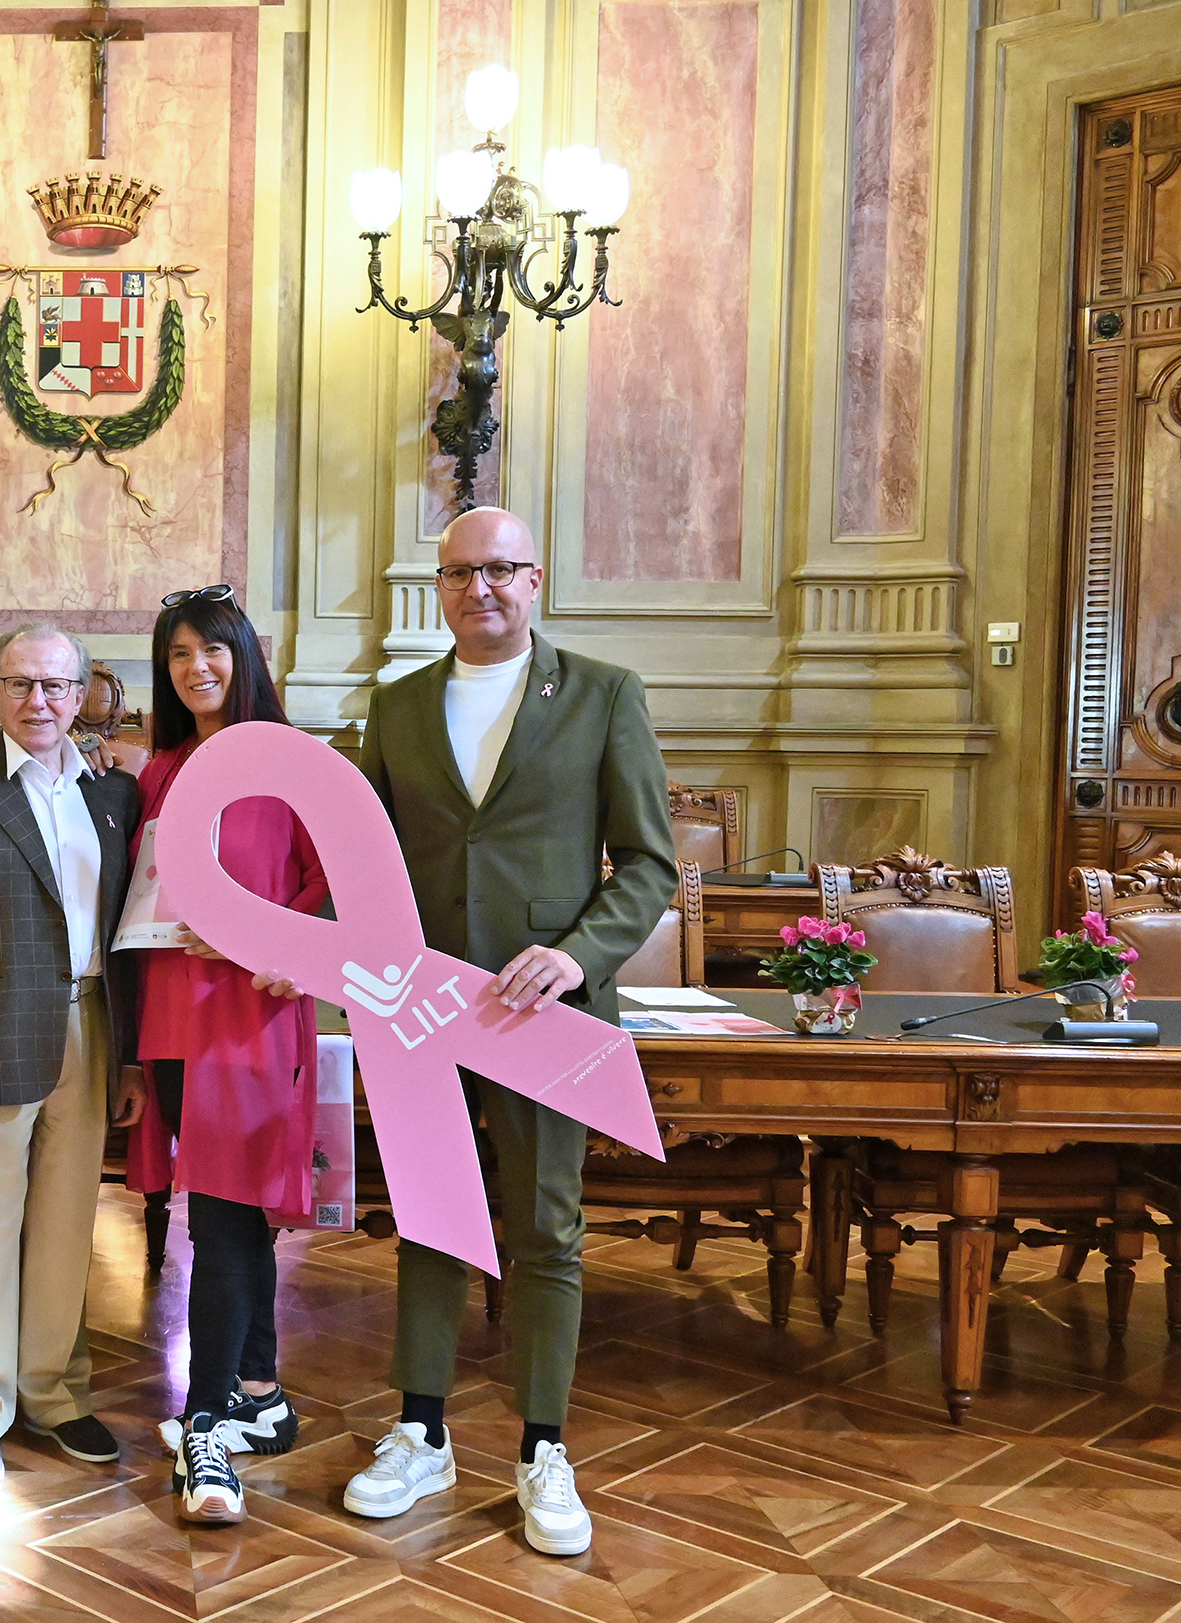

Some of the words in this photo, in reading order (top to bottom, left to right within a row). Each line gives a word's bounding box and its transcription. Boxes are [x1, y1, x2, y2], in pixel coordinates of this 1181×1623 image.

[390, 975, 468, 1050] LILT
[573, 1058, 602, 1085] prevenire
[606, 1037, 626, 1054] vivere
